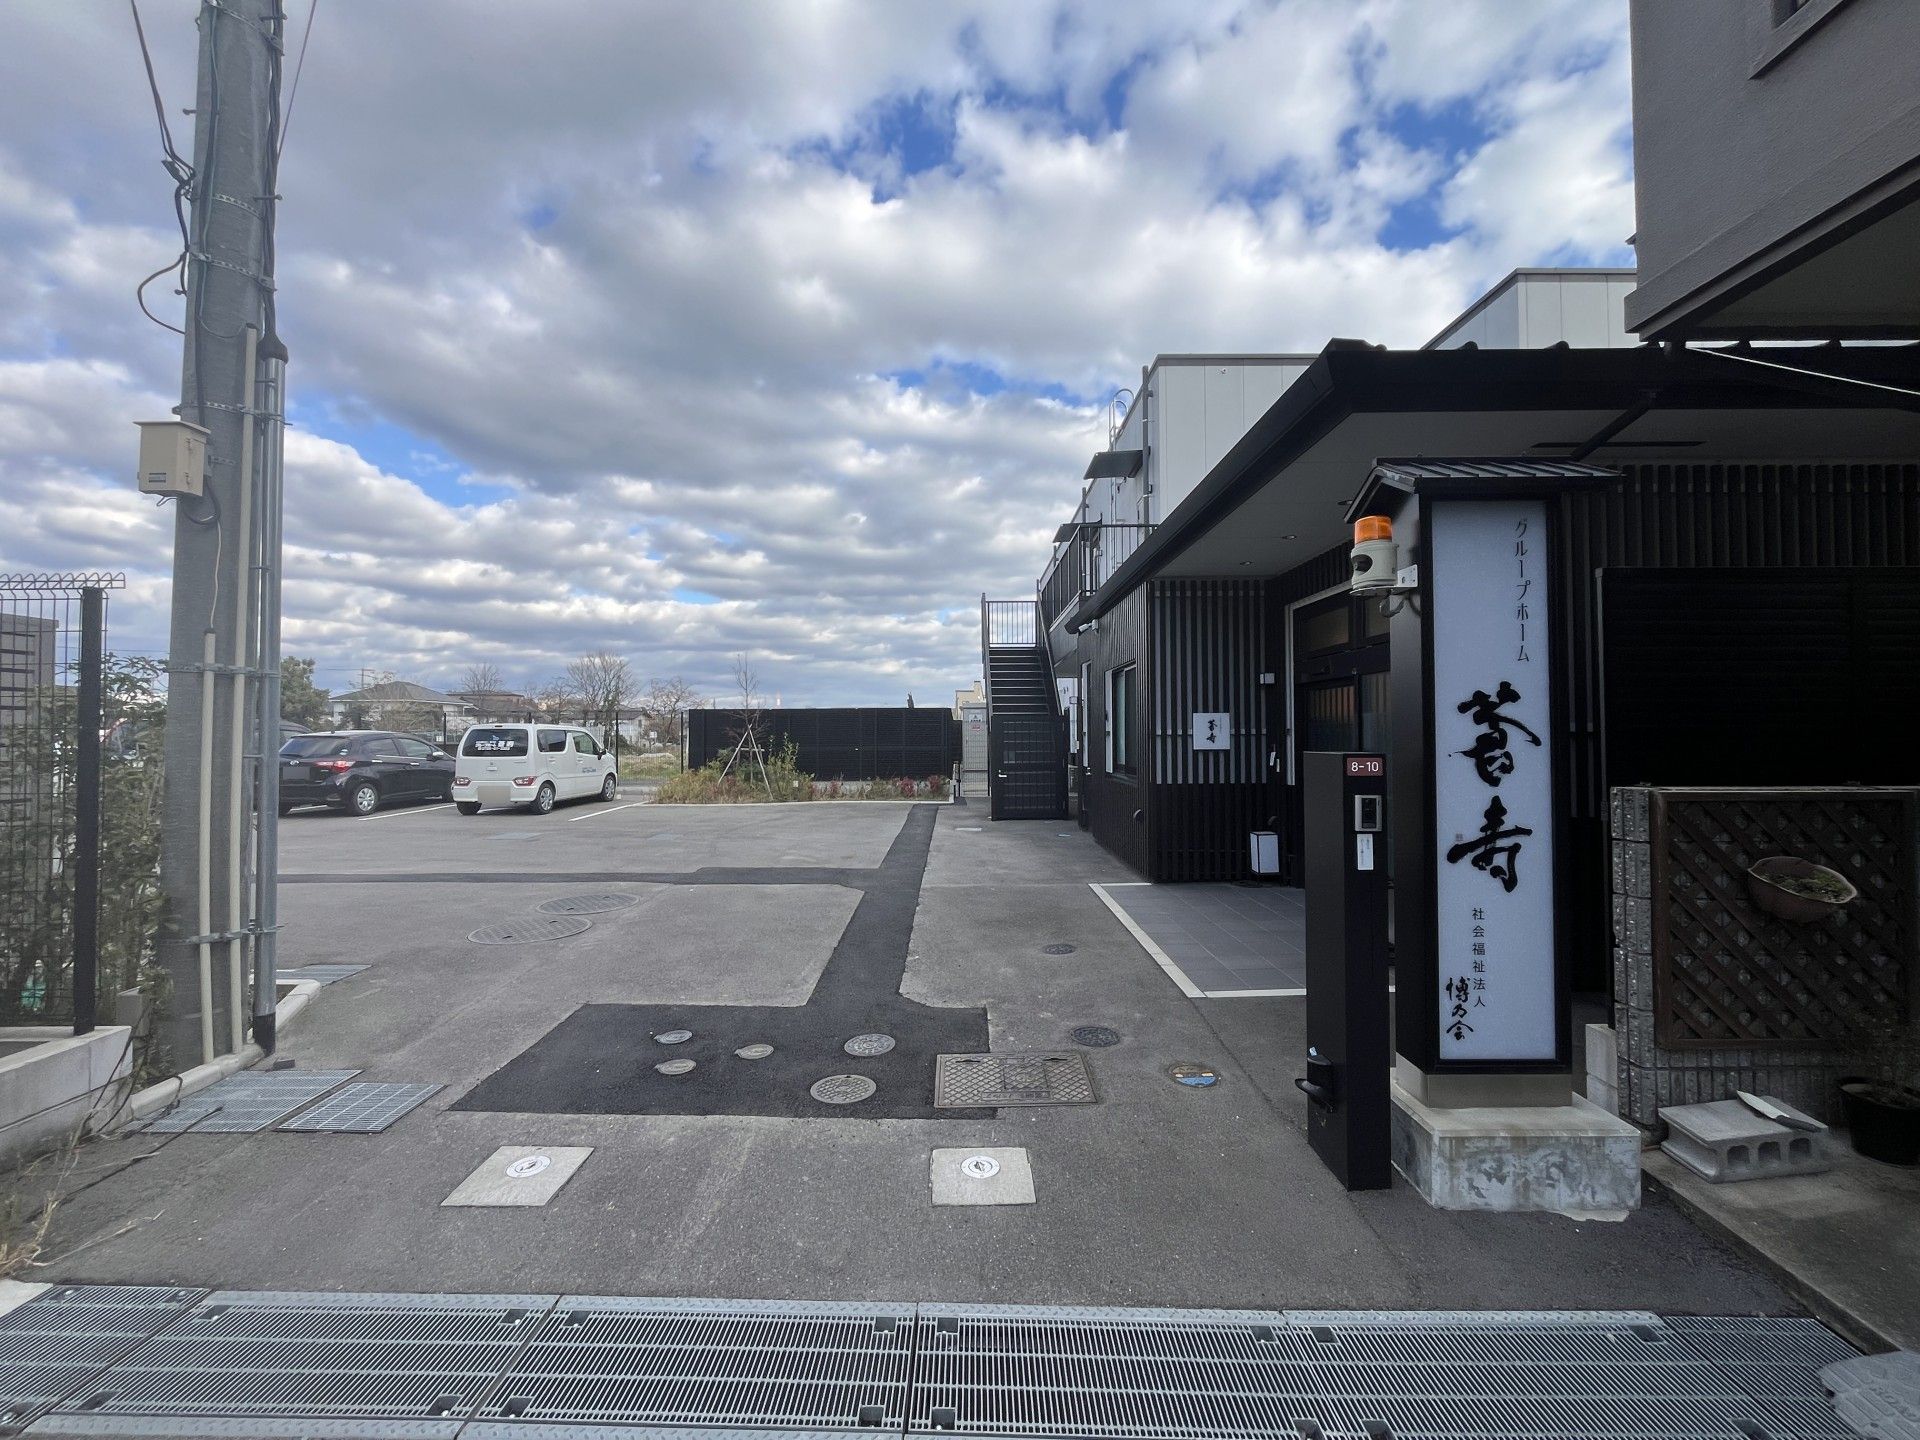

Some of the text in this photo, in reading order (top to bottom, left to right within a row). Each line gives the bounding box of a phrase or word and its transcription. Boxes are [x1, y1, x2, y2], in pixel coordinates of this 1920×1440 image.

[1514, 518, 1532, 662] グループホーム
[1351, 761, 1379, 772] 8-10
[1472, 907, 1486, 1008] 社会福祉法人
